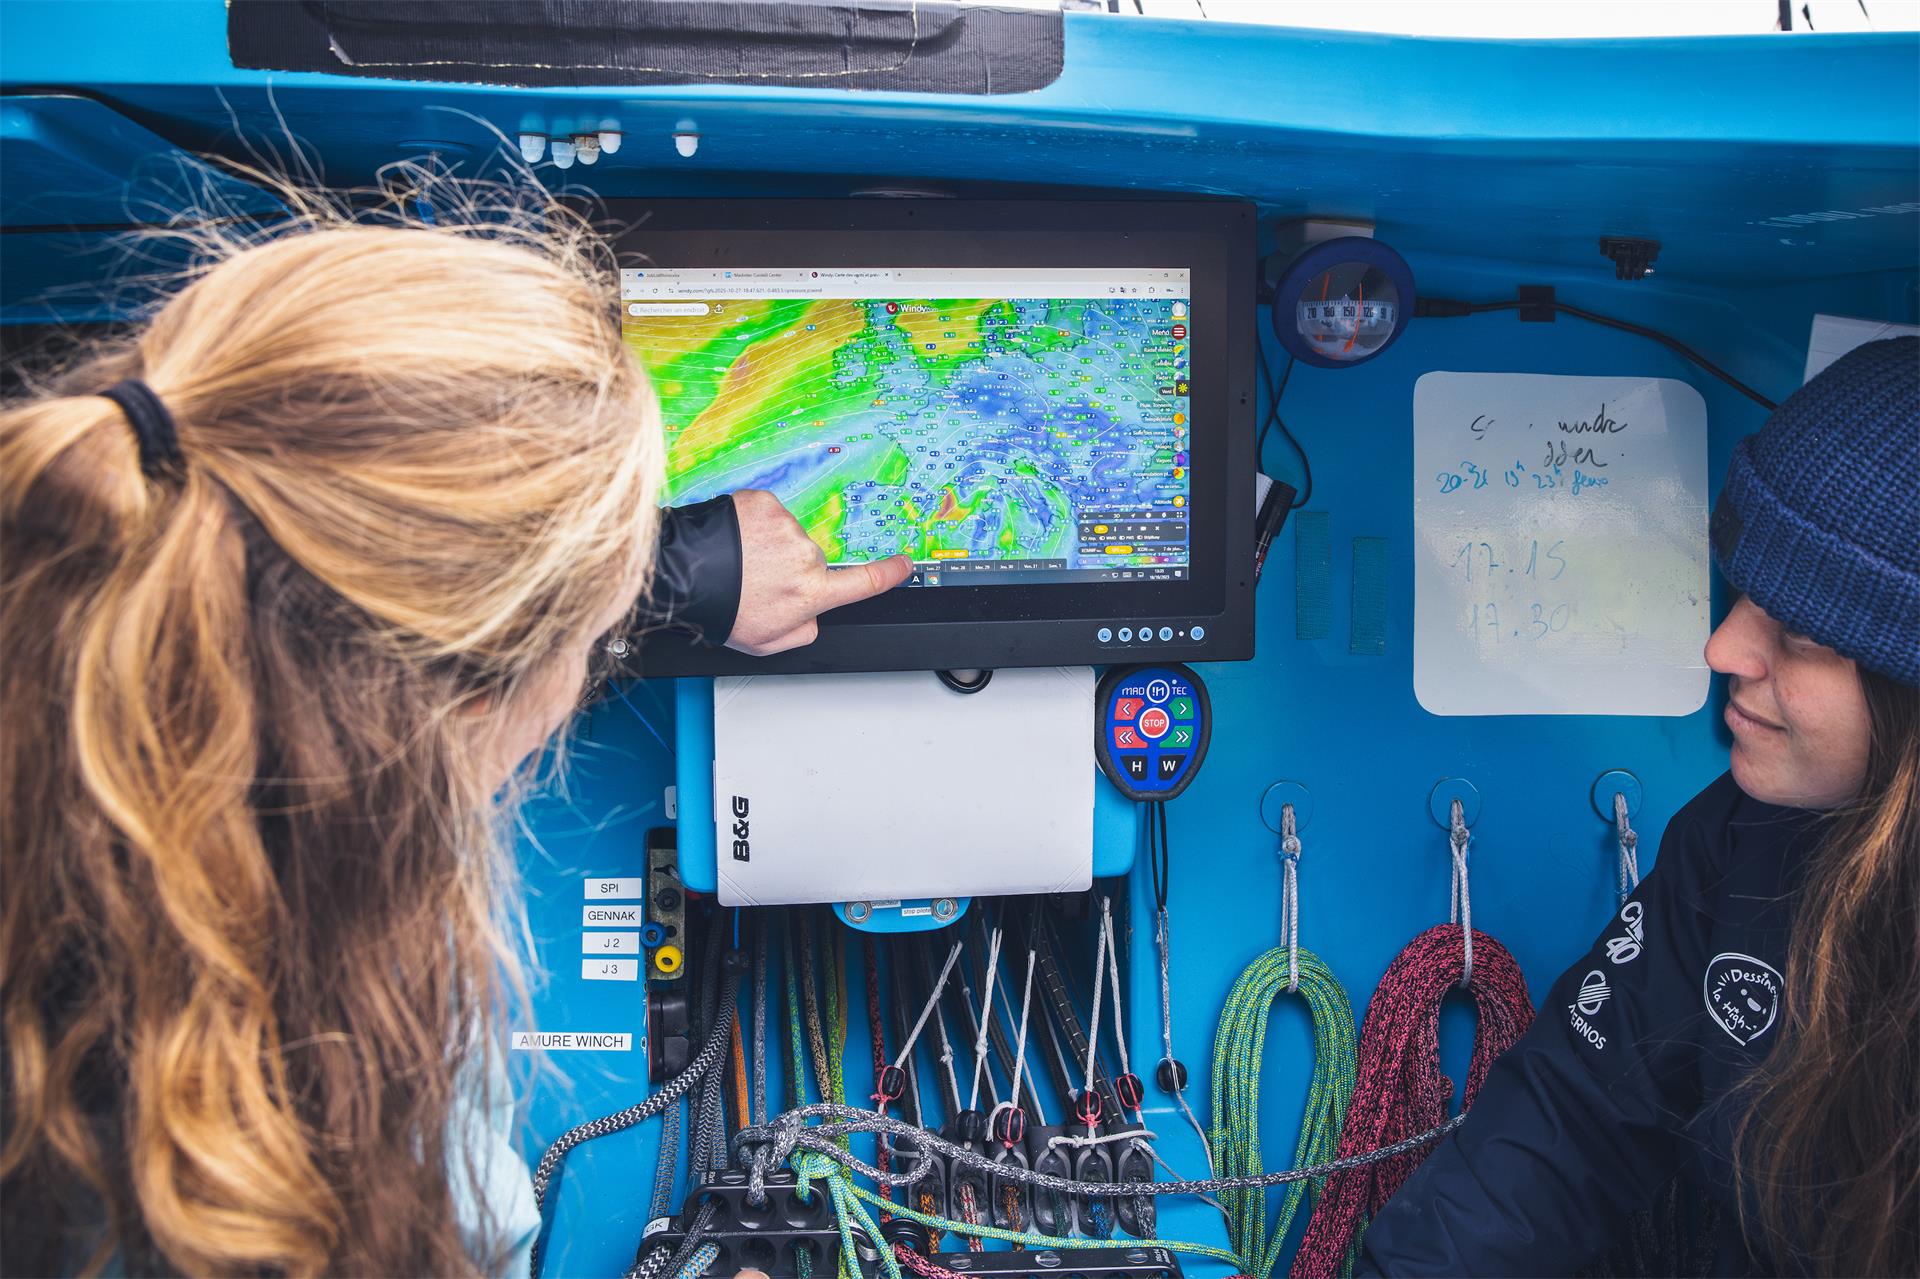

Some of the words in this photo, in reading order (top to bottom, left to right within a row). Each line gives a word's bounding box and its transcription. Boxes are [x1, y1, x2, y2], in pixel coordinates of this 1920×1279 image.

[1343, 306, 1355, 318] 150
[1172, 686, 1187, 696] TEC
[1144, 719, 1165, 728] STOP
[1132, 761, 1142, 772] H
[1163, 760, 1176, 772] W
[733, 796, 750, 863] B&G
[600, 884, 619, 893] SPI
[588, 911, 636, 921] GENNAK
[520, 1034, 571, 1048] AMURE
[576, 1035, 623, 1048] WINCH
